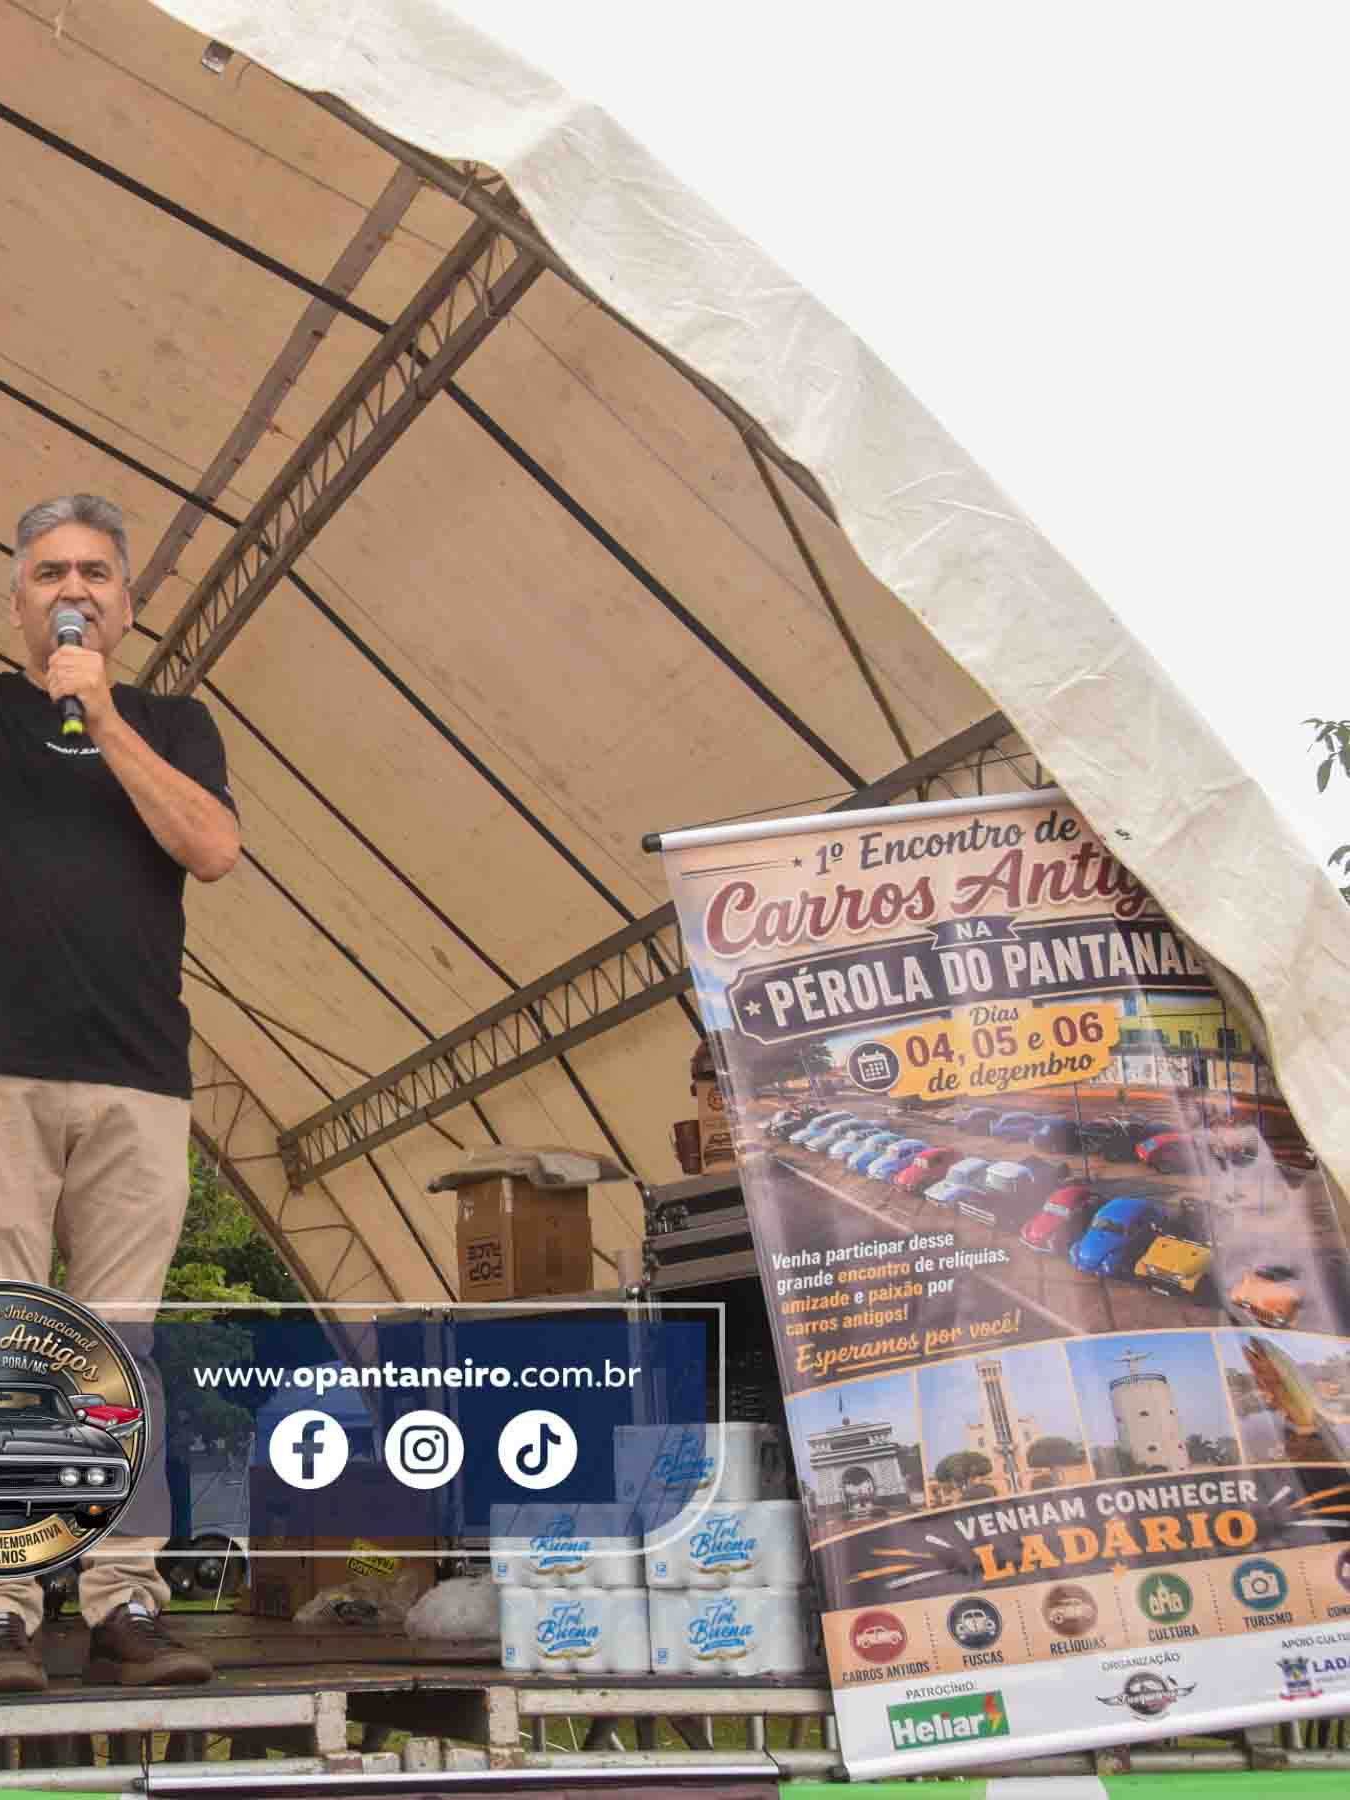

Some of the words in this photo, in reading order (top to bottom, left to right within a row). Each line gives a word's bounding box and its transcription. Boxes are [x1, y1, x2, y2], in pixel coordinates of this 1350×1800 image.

[814, 842, 844, 876] 1º
[858, 818, 1026, 870] Encontro
[1034, 809, 1081, 842] de
[706, 876, 936, 955] Carros
[950, 841, 1150, 917] Antig
[955, 920, 993, 942] NA
[764, 955, 934, 1027] PÉROLA
[939, 948, 994, 995] DO
[1001, 931, 1206, 988] PANTANAL
[970, 1004, 1020, 1027] Dias
[905, 1032, 967, 1068] 04,
[972, 1025, 1019, 1059] 05
[1028, 1031, 1045, 1051] e
[1052, 1011, 1104, 1048] 06
[927, 1066, 961, 1094] de
[970, 1050, 1096, 1090] dezembro
[771, 1250, 822, 1271] Venha
[826, 1238, 905, 1267] participar
[908, 1231, 955, 1251] desse
[776, 1272, 834, 1296] grande
[837, 1261, 911, 1284] encontro
[915, 1256, 935, 1273] de
[781, 1292, 850, 1315] amizade
[853, 1291, 865, 1304] e
[868, 1280, 924, 1306] paixão
[928, 1277, 955, 1297] por
[786, 1316, 839, 1337] carros
[842, 1303, 909, 1328] antigos!
[796, 1331, 920, 1377] Esperamos
[924, 1326, 964, 1355] por
[969, 1308, 1022, 1339] você!
[954, 1496, 1087, 1541] VENHAM
[1096, 1479, 1259, 1517] CONHECER
[706, 1516, 741, 1537] Tri
[689, 1530, 757, 1560] Buena
[551, 1601, 585, 1625] Tri
[705, 1602, 738, 1624] Tri
[1242, 1611, 1293, 1630] TURISMO
[536, 1619, 600, 1645] Buena
[686, 1618, 755, 1645] Buena
[1147, 1624, 1201, 1642] CULTURA
[962, 1650, 1004, 1667] FUSCAS
[1049, 1637, 1107, 1657] RELÍQUIAS
[842, 1667, 884, 1683] CARROS
[886, 1661, 930, 1679] ANTIGOS
[1101, 1651, 1181, 1671] ORGANIZAÇÃO
[1311, 1656, 1350, 1673] LAD
[890, 1711, 986, 1747] Heliar
